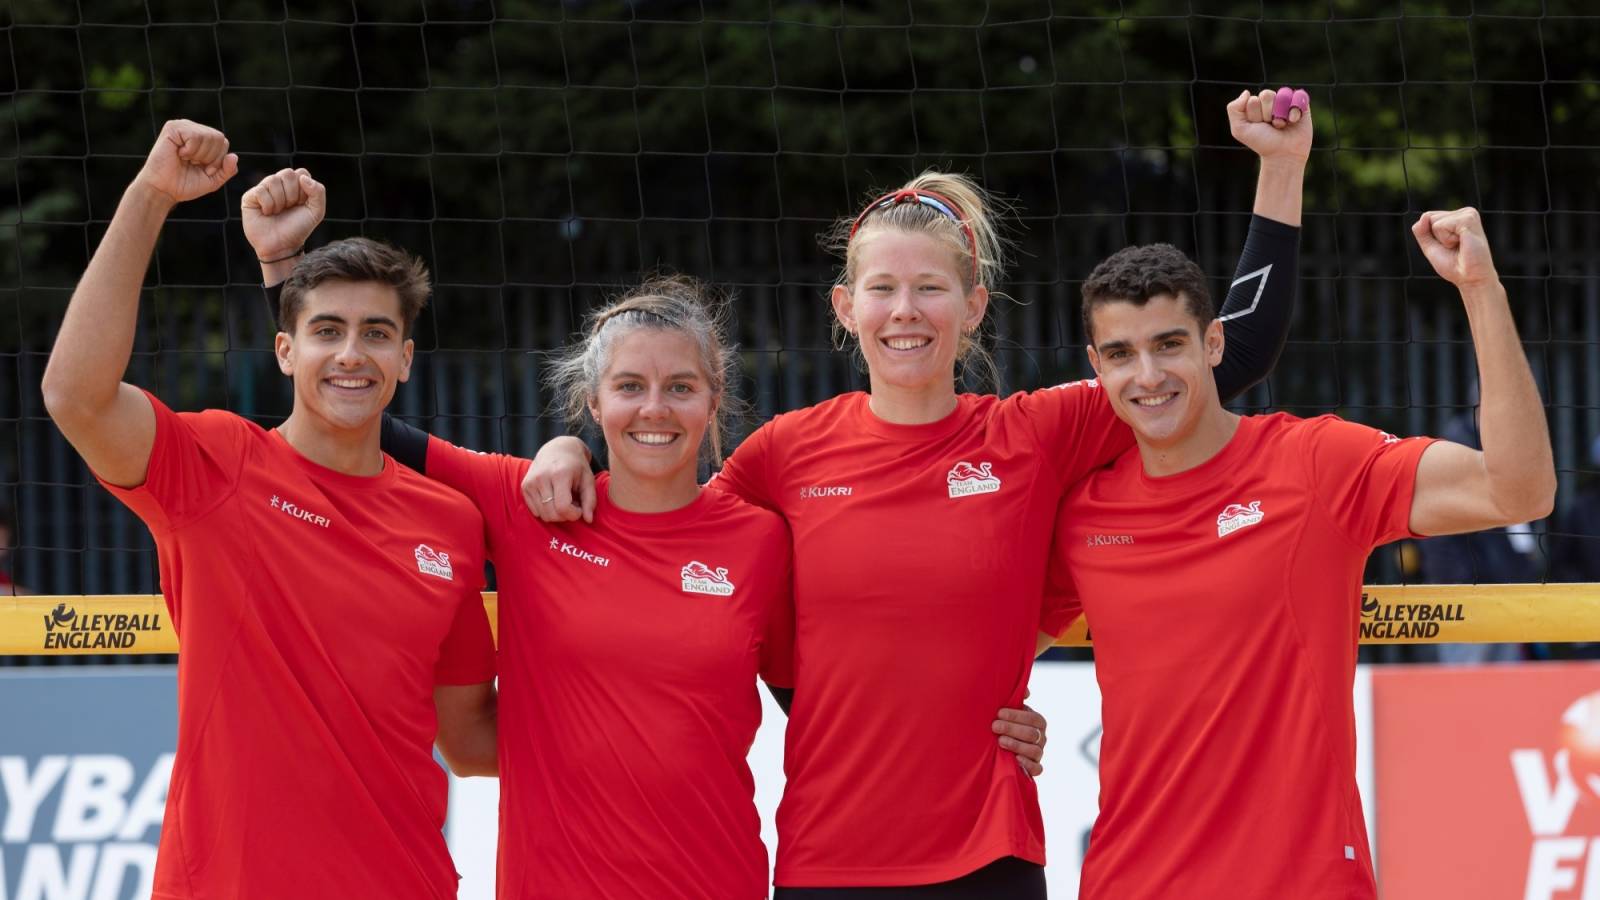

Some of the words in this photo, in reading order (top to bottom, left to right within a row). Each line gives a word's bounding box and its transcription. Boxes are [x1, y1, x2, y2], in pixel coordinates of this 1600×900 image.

[808, 486, 853, 497] KUKRI
[950, 483, 998, 495] ENGLAND
[281, 500, 331, 528] KUKRI
[1094, 534, 1135, 546] KUKRI
[560, 542, 609, 567] KUKRI
[684, 582, 731, 594] ENGLAND
[1359, 622, 1440, 639] NGLAND
[44, 632, 136, 649] ENGLAND
